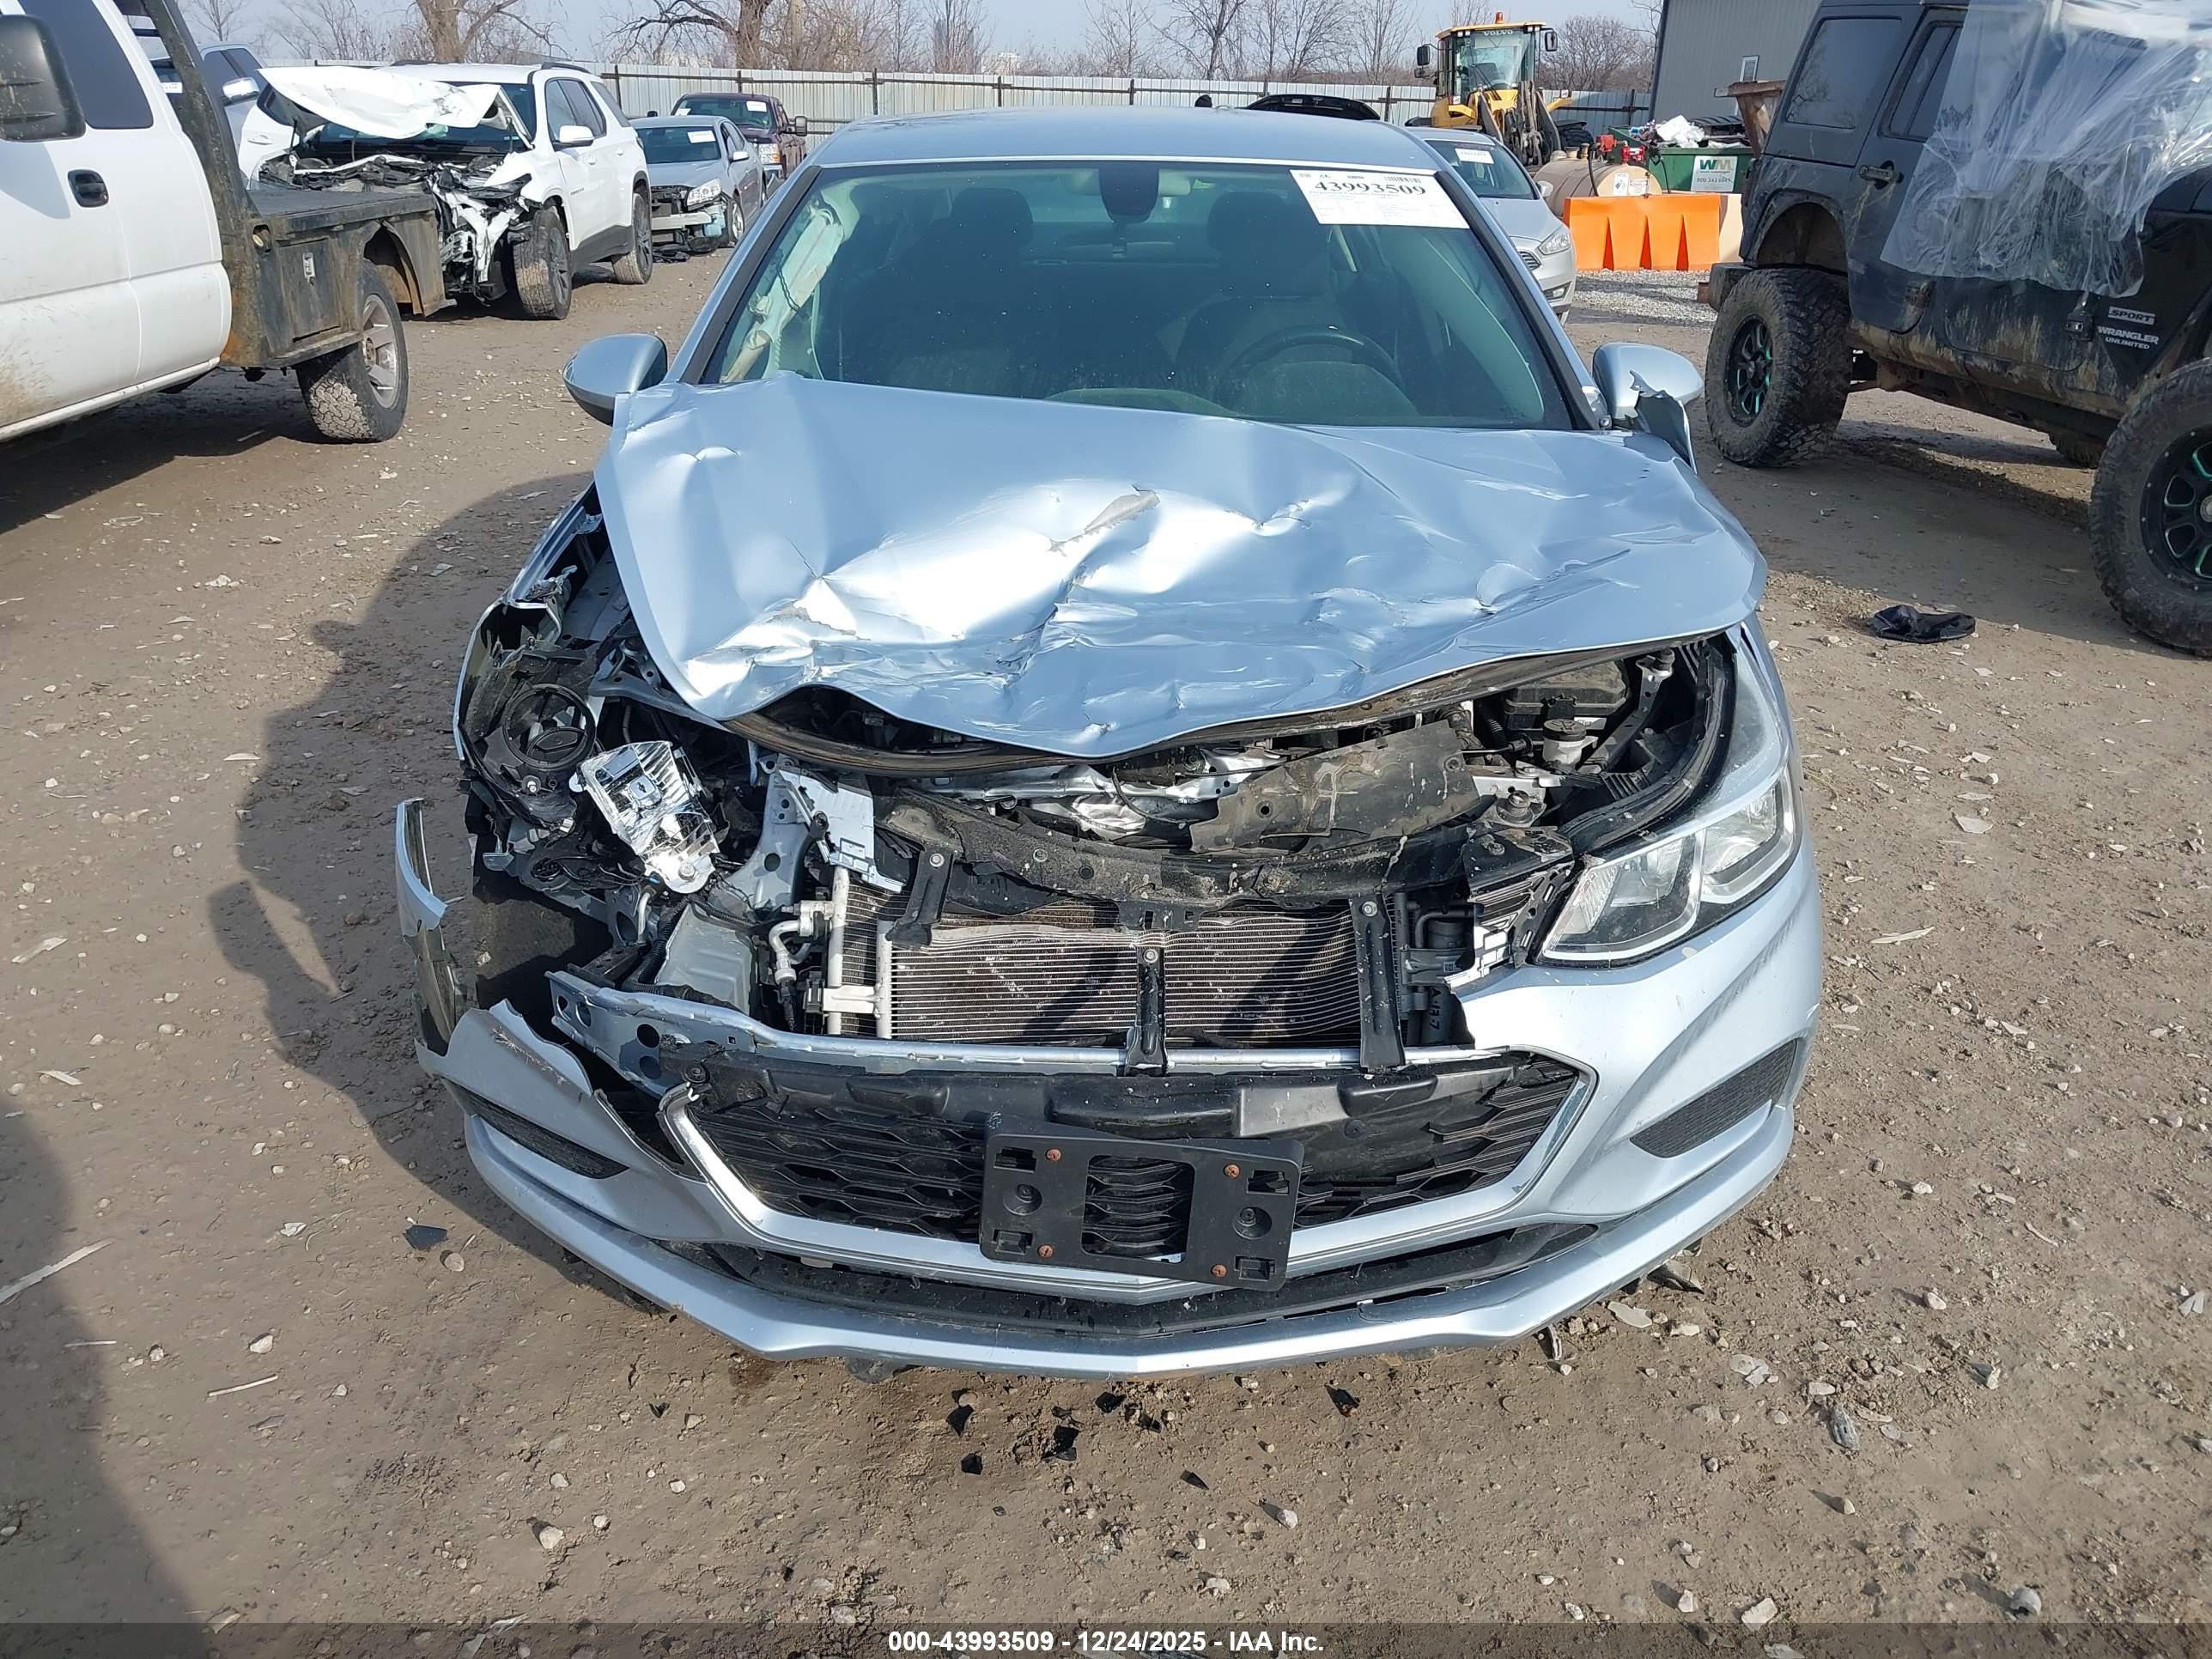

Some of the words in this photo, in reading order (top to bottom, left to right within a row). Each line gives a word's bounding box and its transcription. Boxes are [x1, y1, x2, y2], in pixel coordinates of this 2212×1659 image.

[1699, 159, 1731, 170] WM
[1315, 181, 1426, 195] 43993509
[2111, 309, 2152, 322] SPORT
[2097, 325, 2160, 345] WRANGLER
[2105, 336, 2150, 349] UNLIMITED
